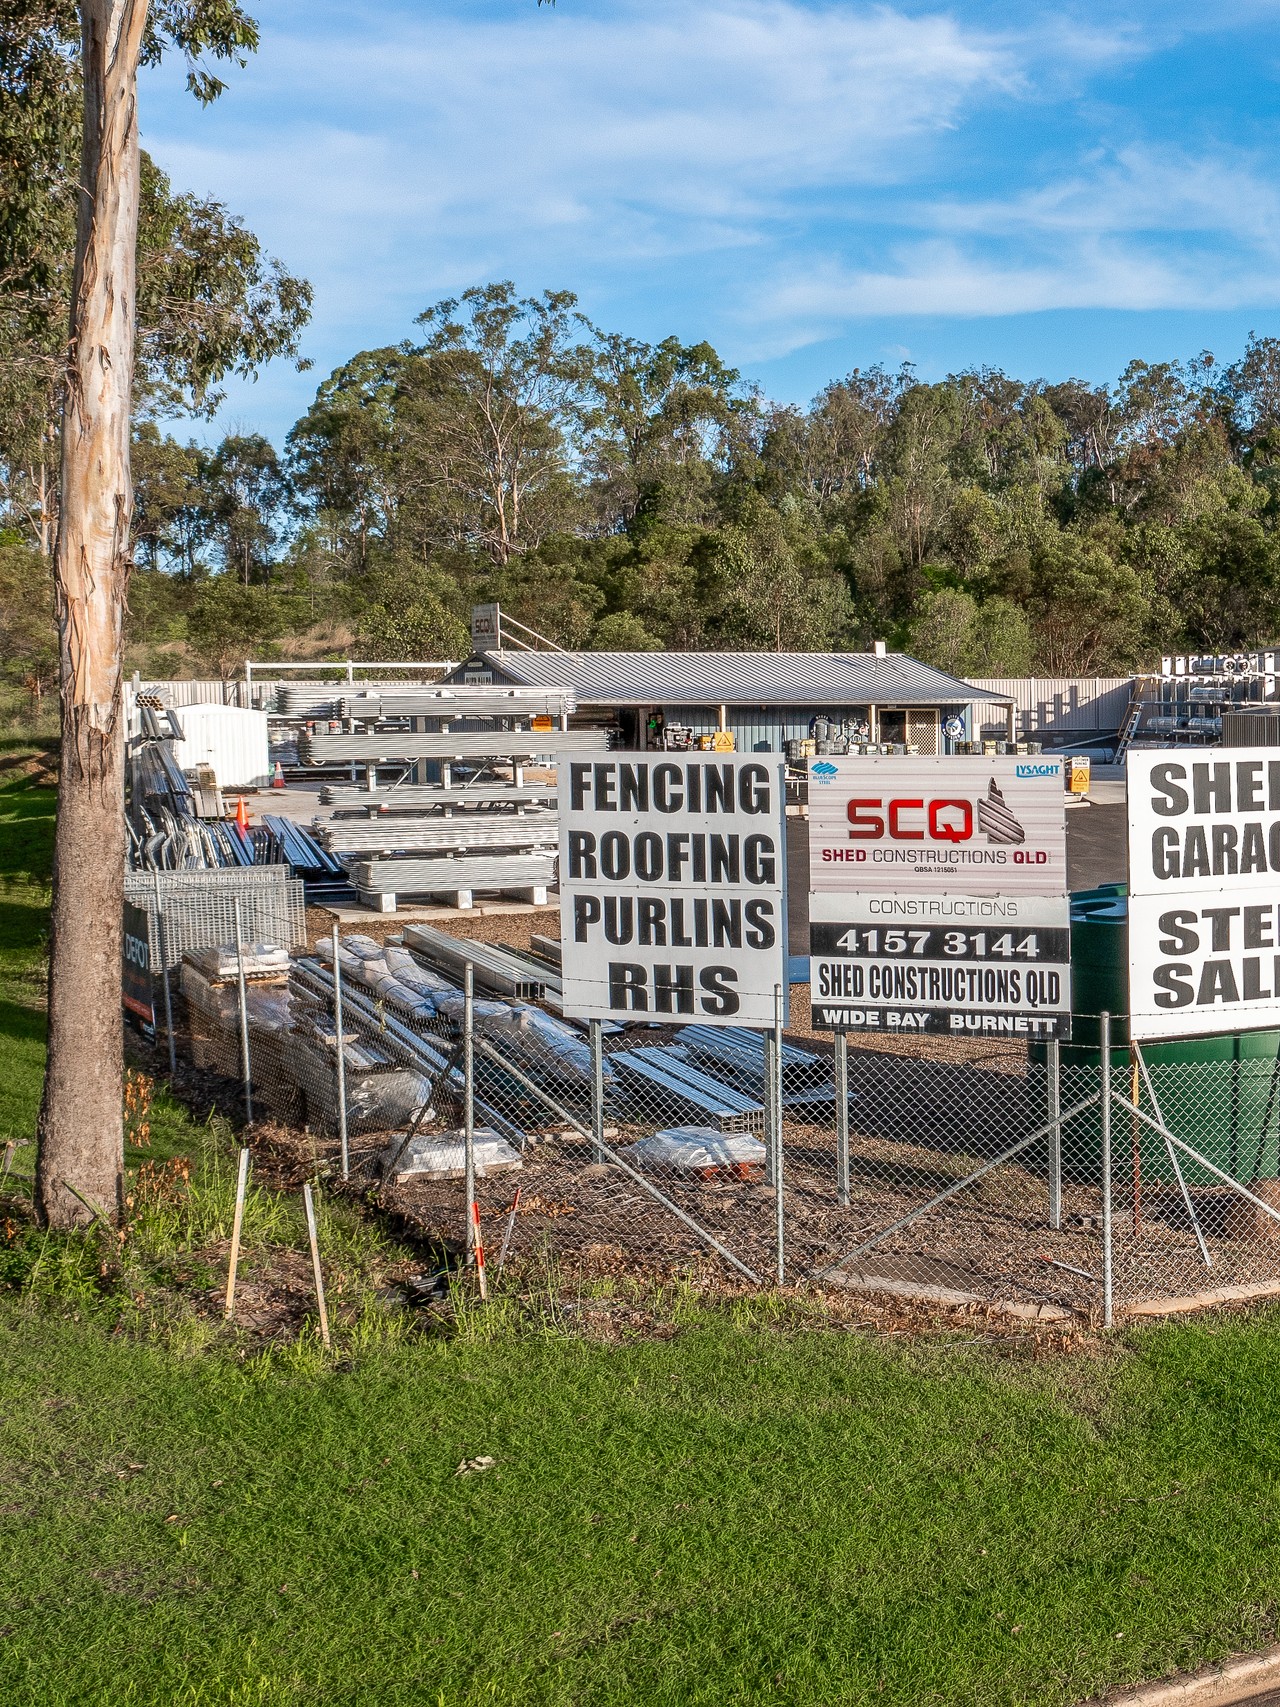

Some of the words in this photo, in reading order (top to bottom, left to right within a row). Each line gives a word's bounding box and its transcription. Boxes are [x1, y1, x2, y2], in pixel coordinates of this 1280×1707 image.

[570, 762, 771, 815] FENCING
[1016, 765, 1060, 778] LYSAGHT
[847, 799, 973, 843] SCQ
[568, 830, 776, 885] ROOFING
[822, 849, 866, 862] SHED
[872, 849, 1007, 864] CONSTRUCTIONS
[1013, 850, 1047, 865] QLD
[573, 894, 775, 950] PURLINS
[869, 899, 1018, 917] CONSTRUCTIONS
[125, 932, 149, 970] DEPOT
[836, 929, 931, 954] 4157
[943, 932, 1040, 958] 3144
[608, 962, 741, 1016] RHS
[819, 963, 864, 998] SHED
[869, 964, 1021, 1004] CONSTRUCTIONS
[1025, 969, 1060, 1008] QLD
[822, 1009, 880, 1026] WIDE
[886, 1011, 930, 1028] BAY
[950, 1014, 1058, 1033] BURNETT
